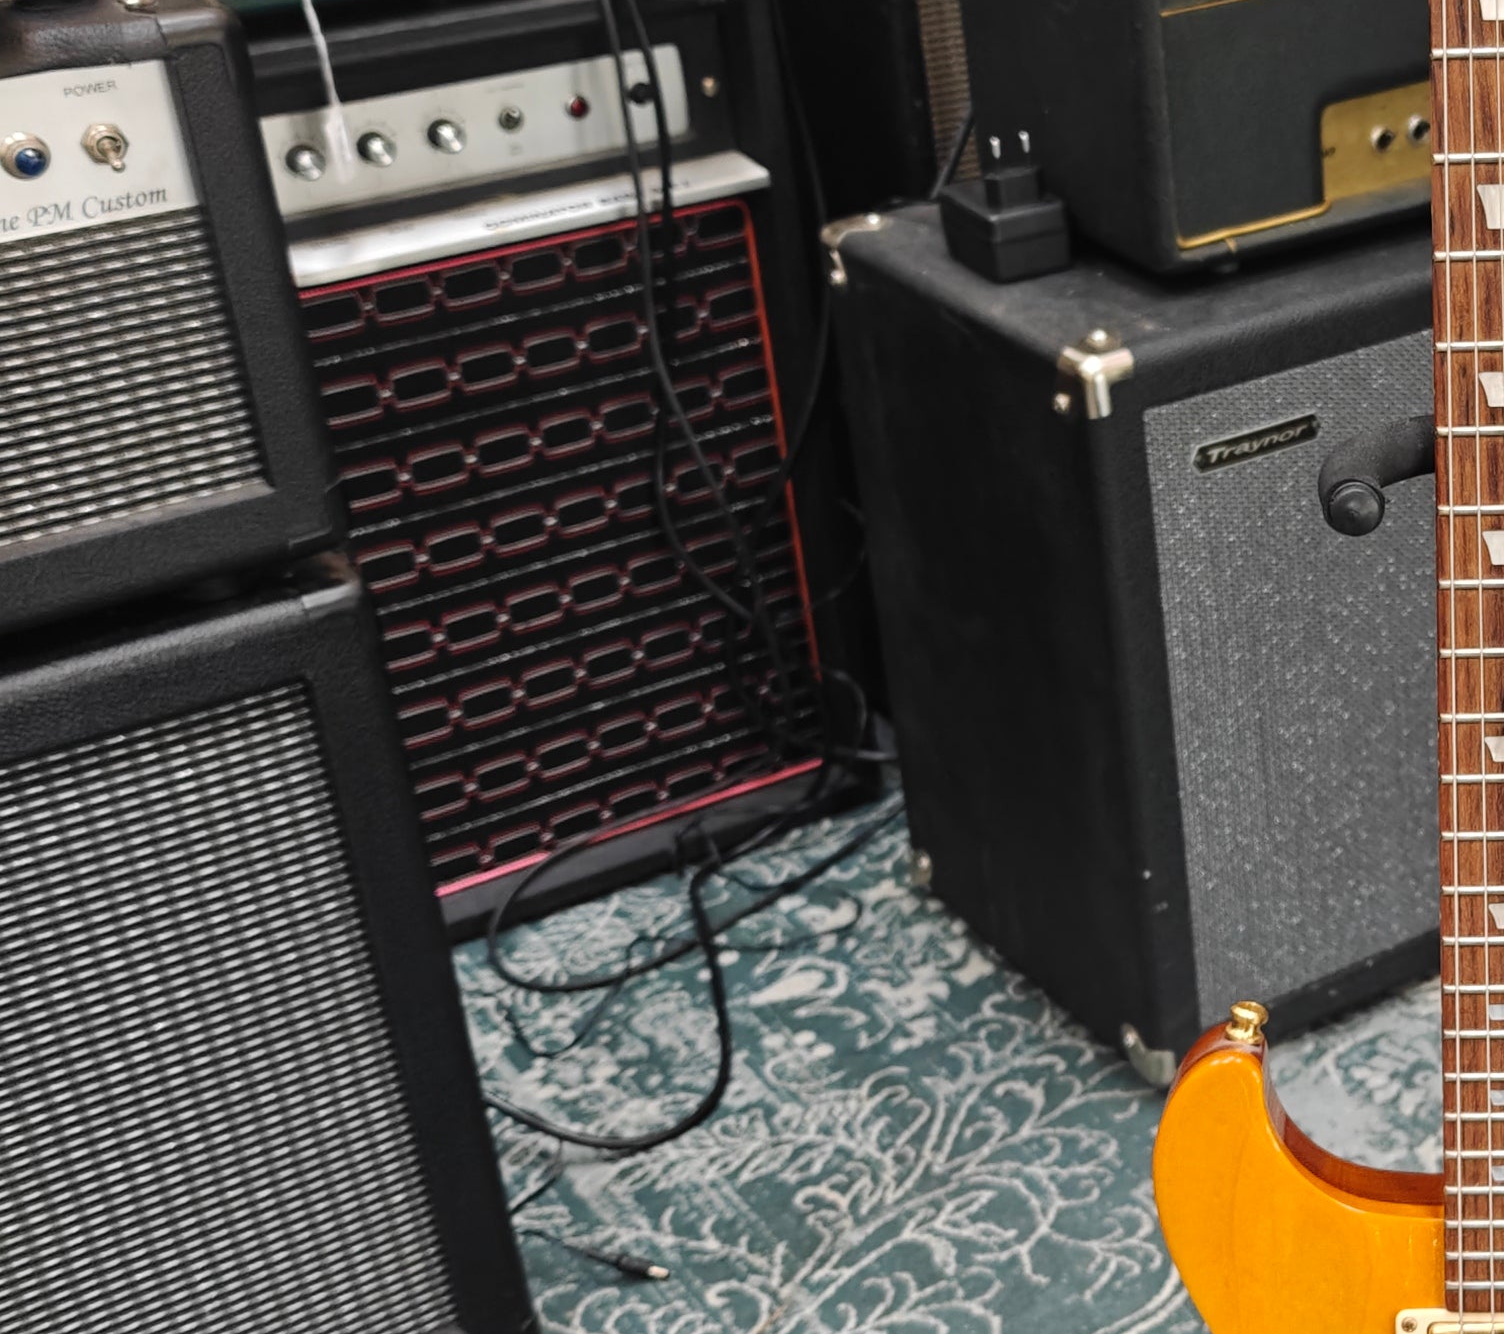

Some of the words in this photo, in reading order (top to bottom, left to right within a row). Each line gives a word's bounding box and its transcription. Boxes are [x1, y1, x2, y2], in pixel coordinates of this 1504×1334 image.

[63, 80, 118, 98] POWER
[27, 200, 73, 227] PM
[82, 188, 168, 218] Custom
[1206, 424, 1309, 464] Traynor
